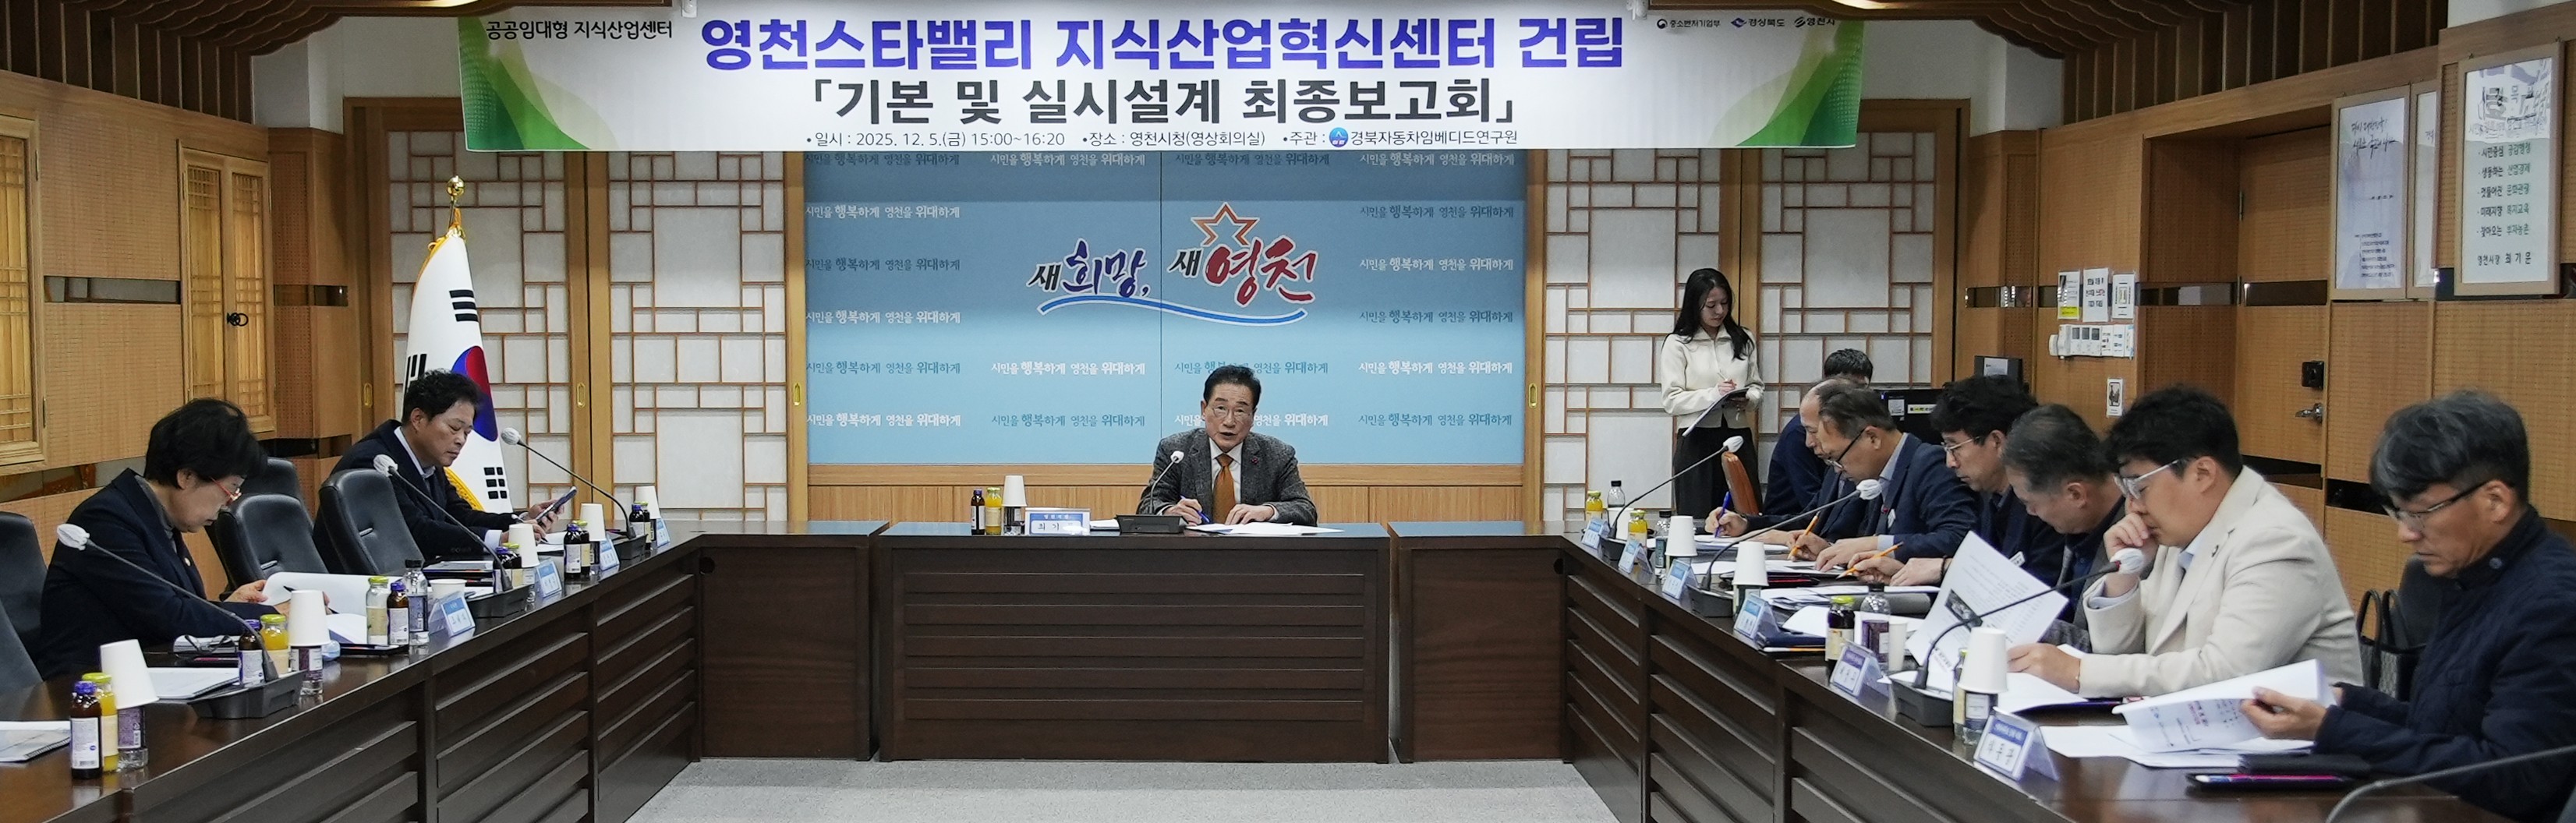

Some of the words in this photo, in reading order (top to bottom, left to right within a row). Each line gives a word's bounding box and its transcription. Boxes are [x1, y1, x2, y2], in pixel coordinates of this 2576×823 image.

[1748, 19, 1785, 27] 경상북도
[1806, 17, 1835, 26] 영천시
[487, 20, 568, 40] 공공임대형
[574, 20, 672, 40] 지식산업센터
[701, 19, 1031, 71] 영천스타밸리
[1056, 17, 1495, 70] 지식산업혁신센터
[1519, 16, 1623, 68] 건립
[815, 79, 934, 125] 「기본
[957, 79, 1002, 125] 및
[1022, 79, 1220, 125] 실시설계
[1242, 78, 1513, 124] 최종보고회」
[816, 133, 842, 146] 일시
[856, 133, 897, 146] 2025.
[904, 133, 924, 146] 12.
[929, 132, 966, 147] 5.(금)
[972, 133, 1065, 146] 15:00~16:20
[1089, 132, 1116, 147] 장소
[1130, 132, 1265, 147] 영천시청(영상회의실)
[1290, 132, 1317, 146] 주관
[1351, 130, 1517, 146] 경북자동차임베디드연구원
[805, 154, 831, 165] 시민을
[834, 153, 879, 166] 행복하게
[884, 154, 911, 165] 영천을
[915, 153, 960, 165] 위대하게
[991, 154, 1018, 165] 시민을
[1020, 154, 1065, 166] 행복하게
[1070, 154, 1098, 166] 영천을
[1101, 153, 1145, 166] 위대하게
[1176, 154, 1202, 165] 시민을
[1205, 153, 1250, 166] 행복하게
[1254, 154, 1282, 165] 영천을
[1286, 153, 1329, 165] 위대하게
[1360, 154, 1388, 165] 시민을
[1390, 153, 1435, 166] 행복하게
[1439, 154, 1467, 165] 영천을
[1470, 153, 1514, 165] 위대하게
[806, 207, 832, 218] 시민을
[835, 204, 879, 218] 행복하게
[885, 206, 912, 218] 영천을
[915, 205, 960, 218] 위대하게
[1360, 207, 1388, 218] 시민을
[1389, 205, 1434, 218] 행복하게
[1439, 207, 1467, 218] 영천을
[1470, 206, 1513, 218] 위대하게
[806, 259, 832, 270] 시민을
[835, 257, 879, 271] 행복하게
[885, 259, 912, 271] 영천을
[916, 258, 961, 270] 위대하게
[1360, 259, 1387, 270] 시민을
[1389, 257, 1434, 271] 행복하게
[1438, 259, 1467, 270] 영천을
[1470, 258, 1513, 270] 위대하게
[2478, 254, 2500, 266] 영천시장
[1028, 264, 1062, 291] 새
[1169, 250, 1202, 276] 새
[1205, 238, 1315, 306] 영천
[806, 312, 833, 323] 시민을
[836, 310, 880, 323] 행복하게
[885, 312, 913, 323] 영천을
[916, 310, 961, 323] 위대하게
[1360, 312, 1386, 323] 시민을
[1389, 310, 1433, 323] 행복하게
[1438, 312, 1466, 323] 영천을
[1470, 310, 1513, 323] 위대하게
[807, 363, 833, 374] 시민을
[837, 361, 880, 374] 행복하게
[886, 362, 913, 374] 영천을
[917, 362, 961, 374] 위대하게
[991, 363, 1018, 375] 시민을
[1021, 362, 1065, 375] 행복하게
[1070, 362, 1099, 375] 영천을
[1101, 362, 1145, 375] 위대하게
[1175, 362, 1202, 374] 시민을
[1254, 362, 1281, 374] 영천을
[1285, 362, 1329, 374] 위대하게
[1359, 362, 1386, 374] 시민을
[1388, 361, 1433, 374] 행복하게
[1438, 362, 1466, 374] 영천을
[1469, 361, 1513, 374] 위대하게
[808, 415, 834, 426] 시민을
[837, 413, 881, 427] 행복하게
[886, 415, 914, 426] 영천을
[917, 414, 961, 426] 위대하게
[992, 415, 1019, 426] 시민을
[1021, 414, 1065, 427] 행복하게
[1070, 415, 1098, 426] 영천을
[1101, 415, 1145, 426] 위대하게
[1175, 415, 1202, 426] 시민을
[1254, 415, 1281, 426] 영천을
[1285, 414, 1329, 426] 위대하게
[1359, 415, 1386, 426] 시민을
[1388, 413, 1432, 426] 행복하게
[1438, 415, 1465, 426] 영천을
[1469, 413, 1513, 426] 위대하게
